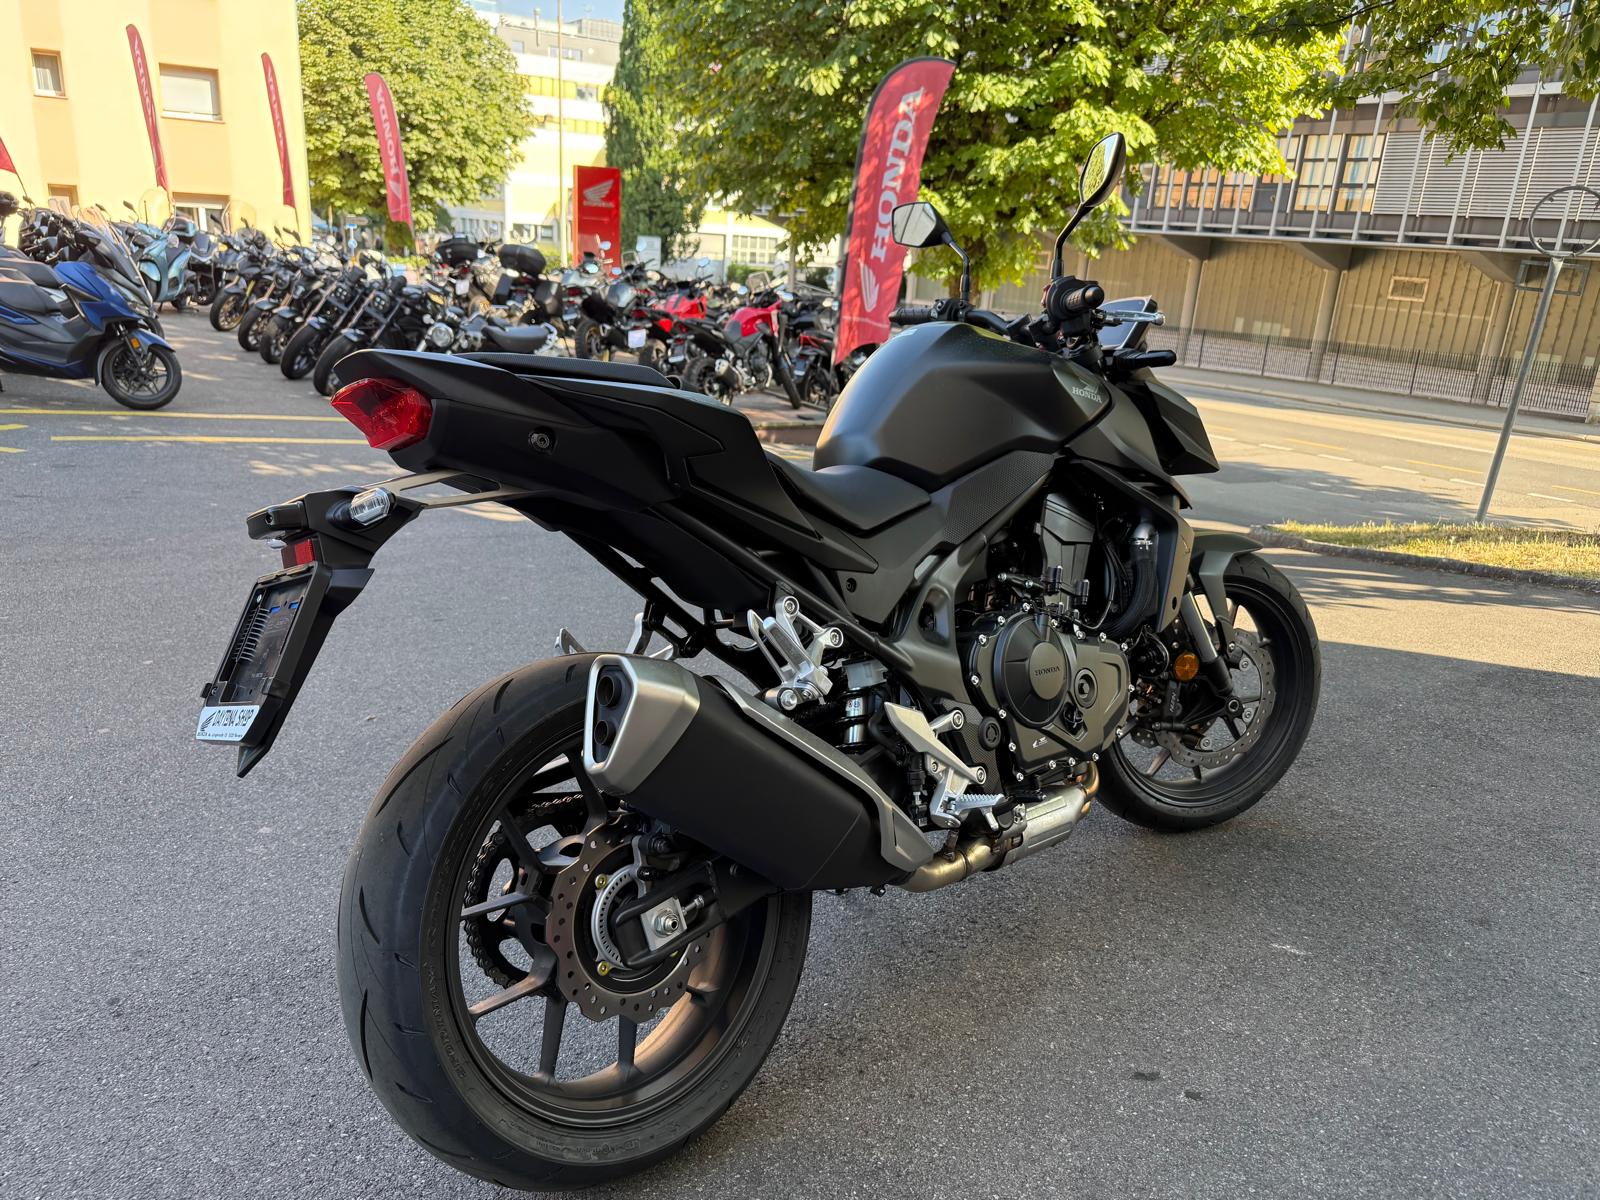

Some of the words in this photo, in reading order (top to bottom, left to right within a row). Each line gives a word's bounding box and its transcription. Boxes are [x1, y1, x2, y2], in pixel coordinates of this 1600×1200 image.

[375, 84, 401, 176] HONDA
[870, 87, 925, 263] HONDA
[1072, 386, 1102, 404] HONDA
[1035, 666, 1060, 676] HONDA
